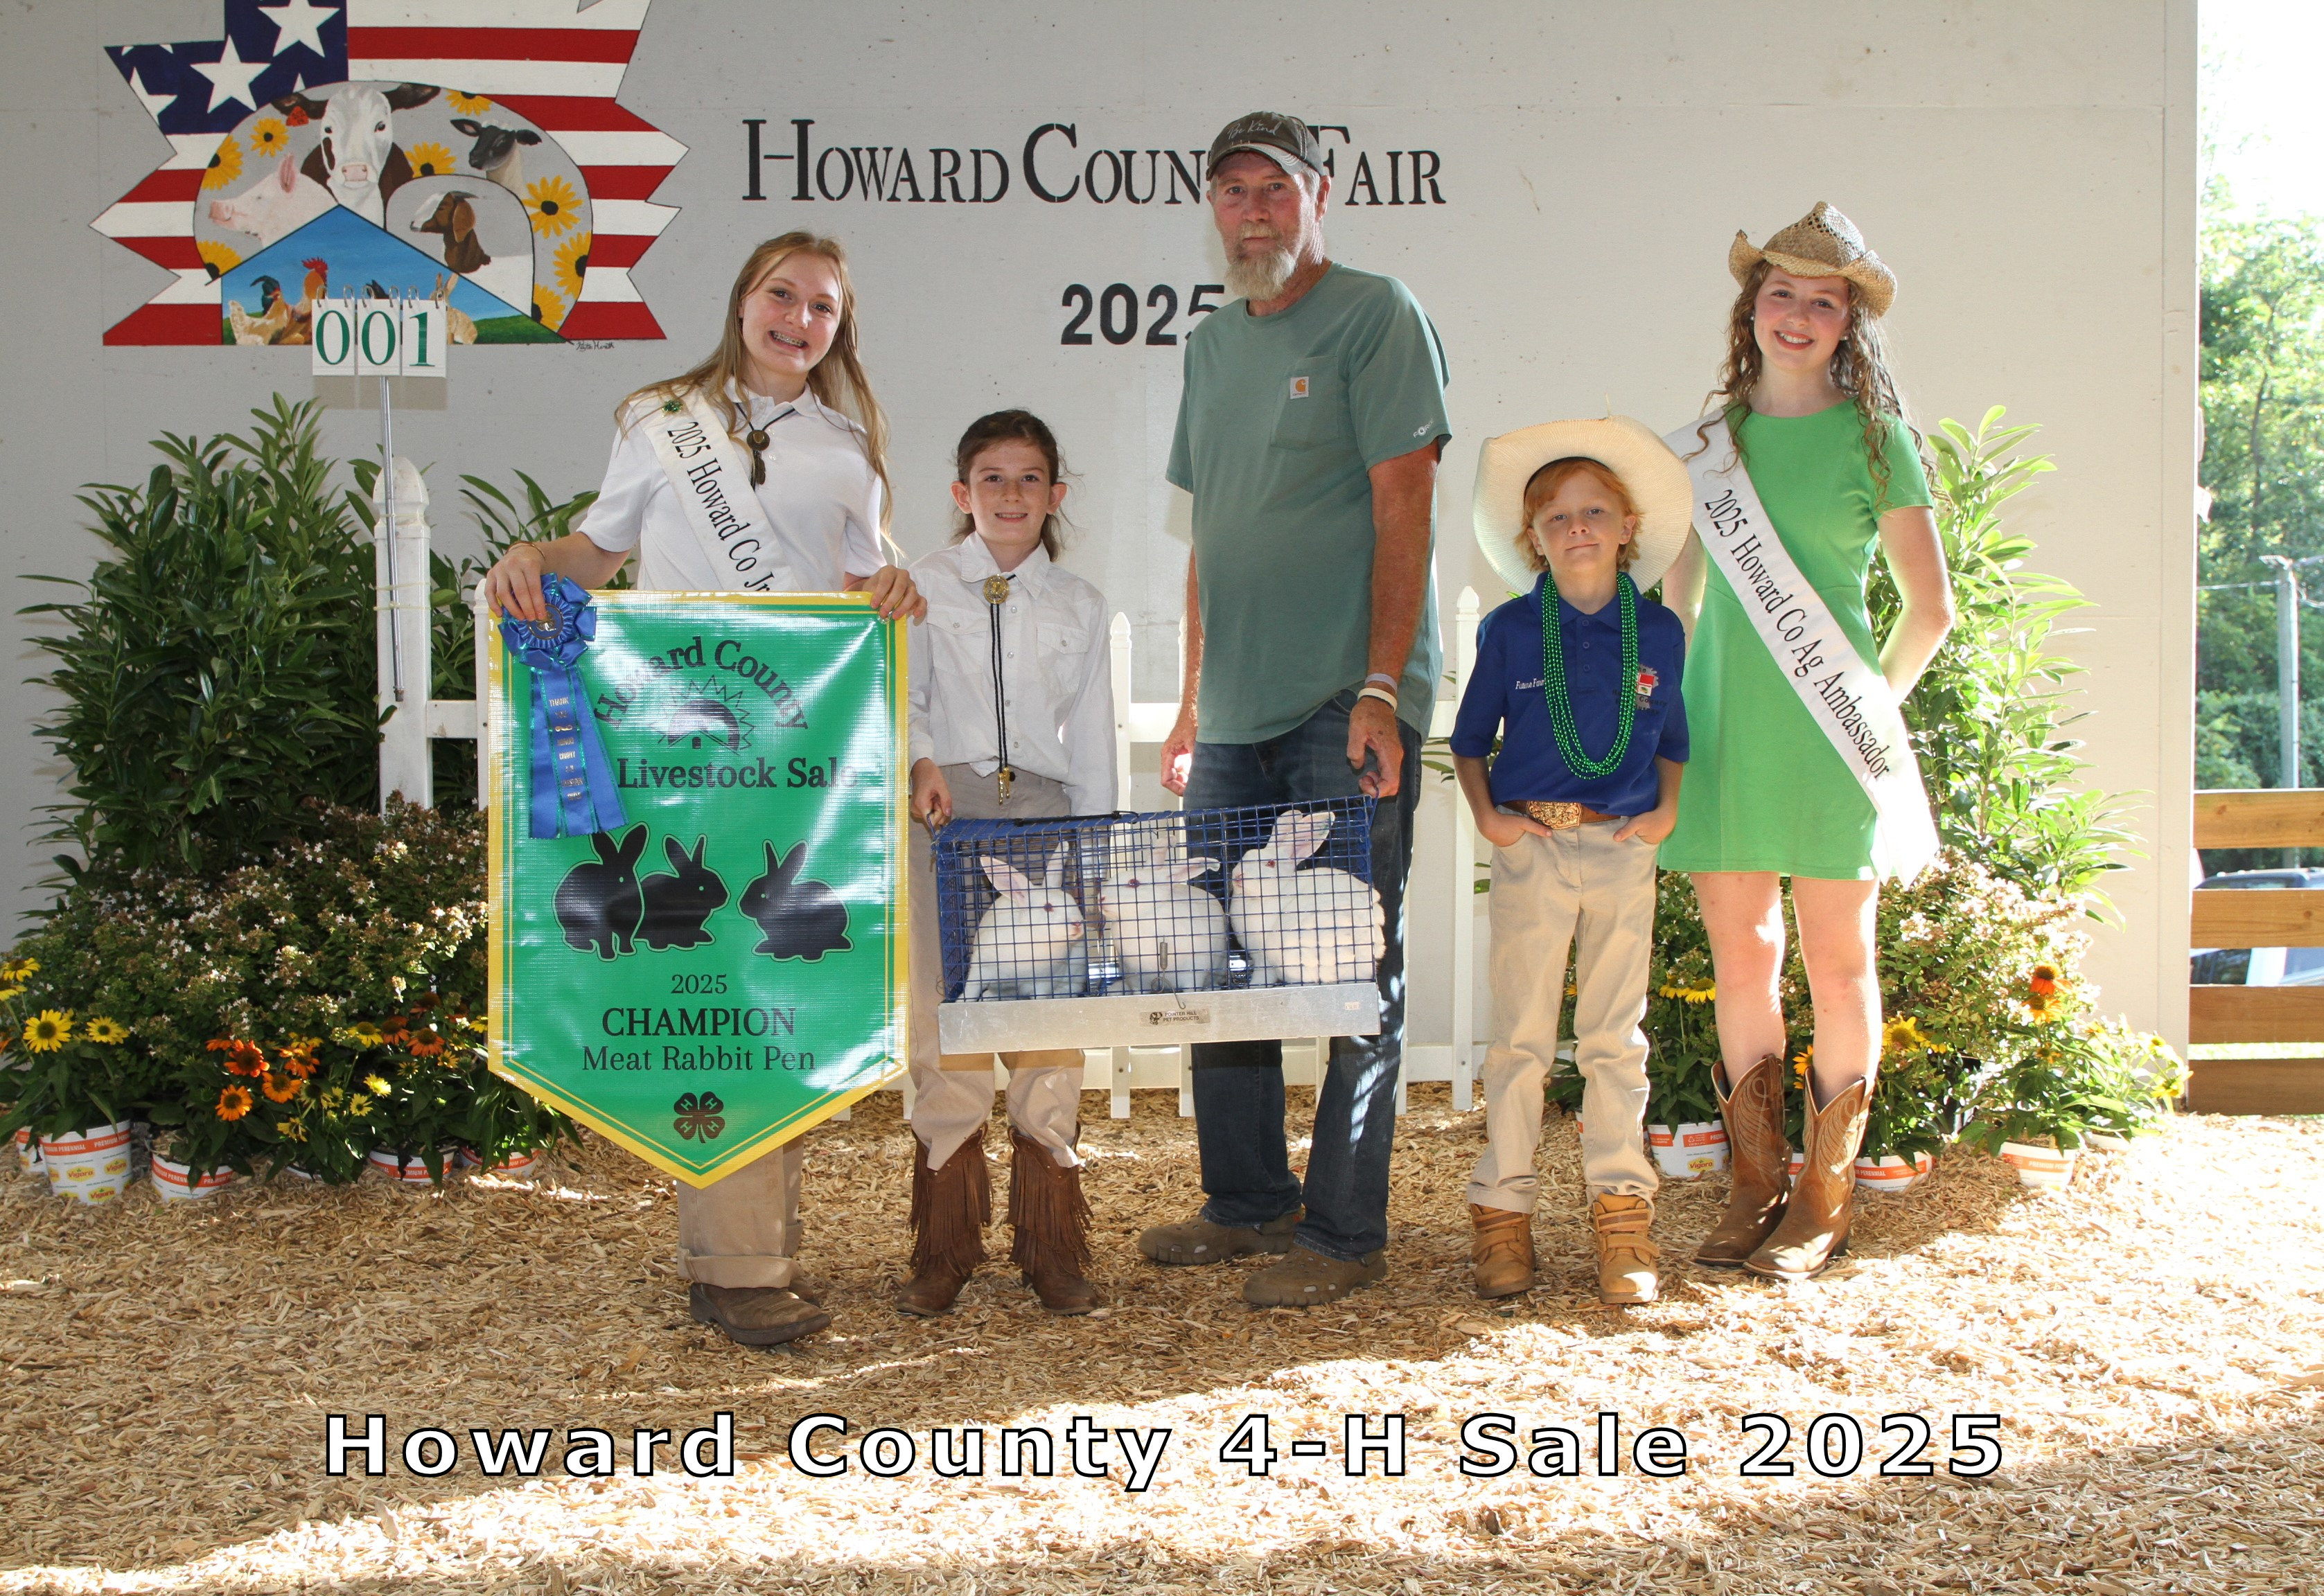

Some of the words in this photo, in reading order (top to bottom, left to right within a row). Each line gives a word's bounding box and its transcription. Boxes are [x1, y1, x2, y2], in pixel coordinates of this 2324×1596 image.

[1247, 119, 1282, 136] Kind
[741, 118, 1010, 204] HOWARD
[1023, 122, 1211, 204] COUN
[315, 309, 436, 367] 001
[667, 421, 712, 459] 2025
[687, 457, 751, 540] Howard
[1705, 489, 1748, 538] 2025
[728, 538, 762, 572] Co
[1729, 533, 1795, 614] Howard
[1776, 608, 1808, 642] Co
[1791, 639, 1824, 678] Ag
[714, 639, 809, 729] County
[549, 697, 569, 707] THANK
[1813, 671, 1890, 779] Ambassador
[617, 757, 777, 788] Livestock
[671, 974, 728, 994] 2025
[602, 1007, 796, 1036] CHAMPION
[582, 1045, 651, 1070] Meat
[662, 1045, 752, 1071] Rabbit
[764, 1047, 816, 1071] Pen
[68, 1169, 94, 1179] Vigoro
[168, 1173, 188, 1183] PERENN
[1690, 1161, 1713, 1170] Vigoro
